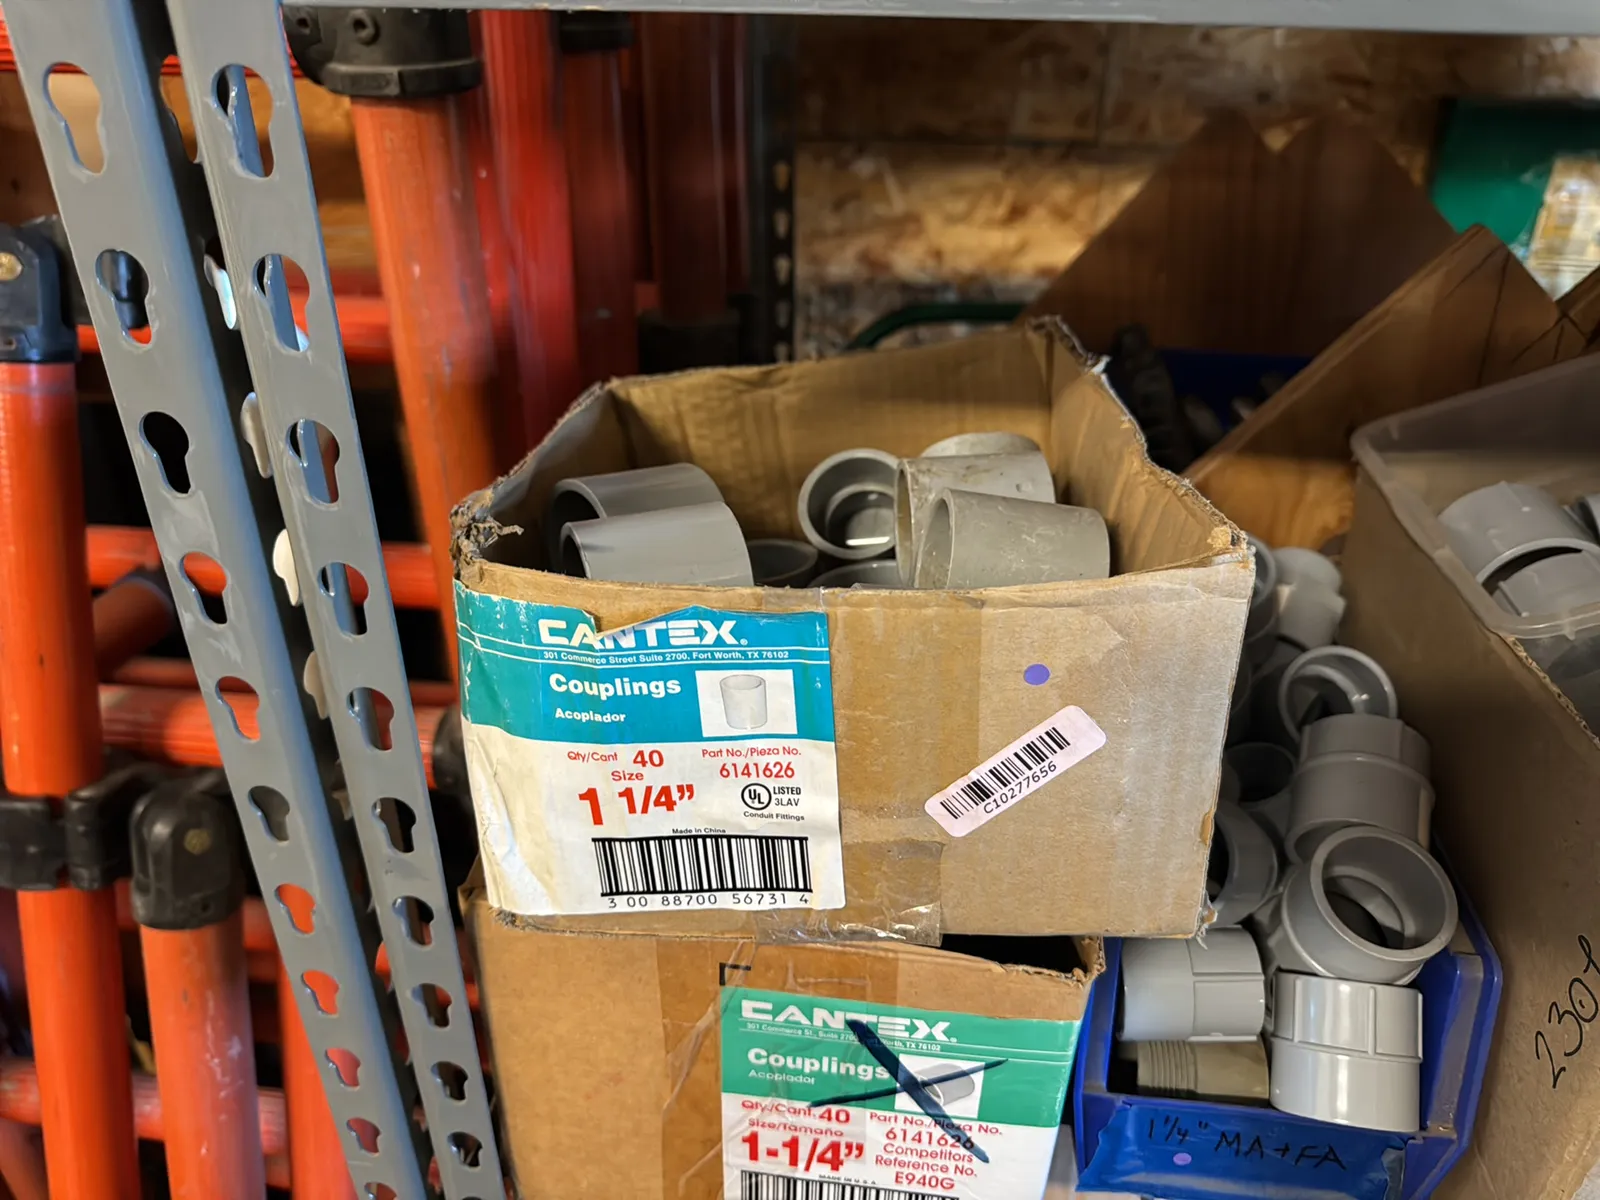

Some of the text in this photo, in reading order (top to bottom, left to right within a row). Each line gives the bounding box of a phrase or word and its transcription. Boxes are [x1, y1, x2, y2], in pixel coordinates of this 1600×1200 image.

[543, 651, 558, 660] 301
[561, 652, 606, 664] Commerce
[609, 654, 636, 664] Street
[639, 653, 663, 662] Suite
[692, 652, 712, 660] Fort
[714, 651, 745, 660] Worth,
[747, 651, 760, 659] TX
[762, 651, 789, 659] 76102
[549, 673, 681, 701] Couplings
[555, 708, 626, 722] Acoplador
[567, 750, 665, 767] Qty/Cant 40
[702, 746, 801, 759] Part No./Pieza No.
[611, 770, 644, 782] Size
[719, 761, 795, 778] 6141626
[772, 786, 802, 796] LISTED
[983, 761, 1057, 814] C10277656
[578, 787, 604, 825] 1
[774, 797, 800, 807] 3LAV
[743, 811, 805, 822] Conduit Fittings
[608, 893, 809, 909] 3 00 88700 56731 4
[741, 999, 951, 1042] CANTEX
[906, 1041, 916, 1049] TX
[918, 1042, 941, 1051] 76102
[747, 1047, 890, 1081] Couplings
[749, 1069, 815, 1085] Acoplador
[818, 1107, 851, 1124] 40
[870, 1111, 898, 1123] Part
[977, 1124, 1003, 1135] No.
[748, 1117, 844, 1137] Size/Tamaño
[883, 1142, 974, 1163] Competitors
[875, 1154, 978, 1177] Reference No.
[895, 1171, 955, 1190] E940G
